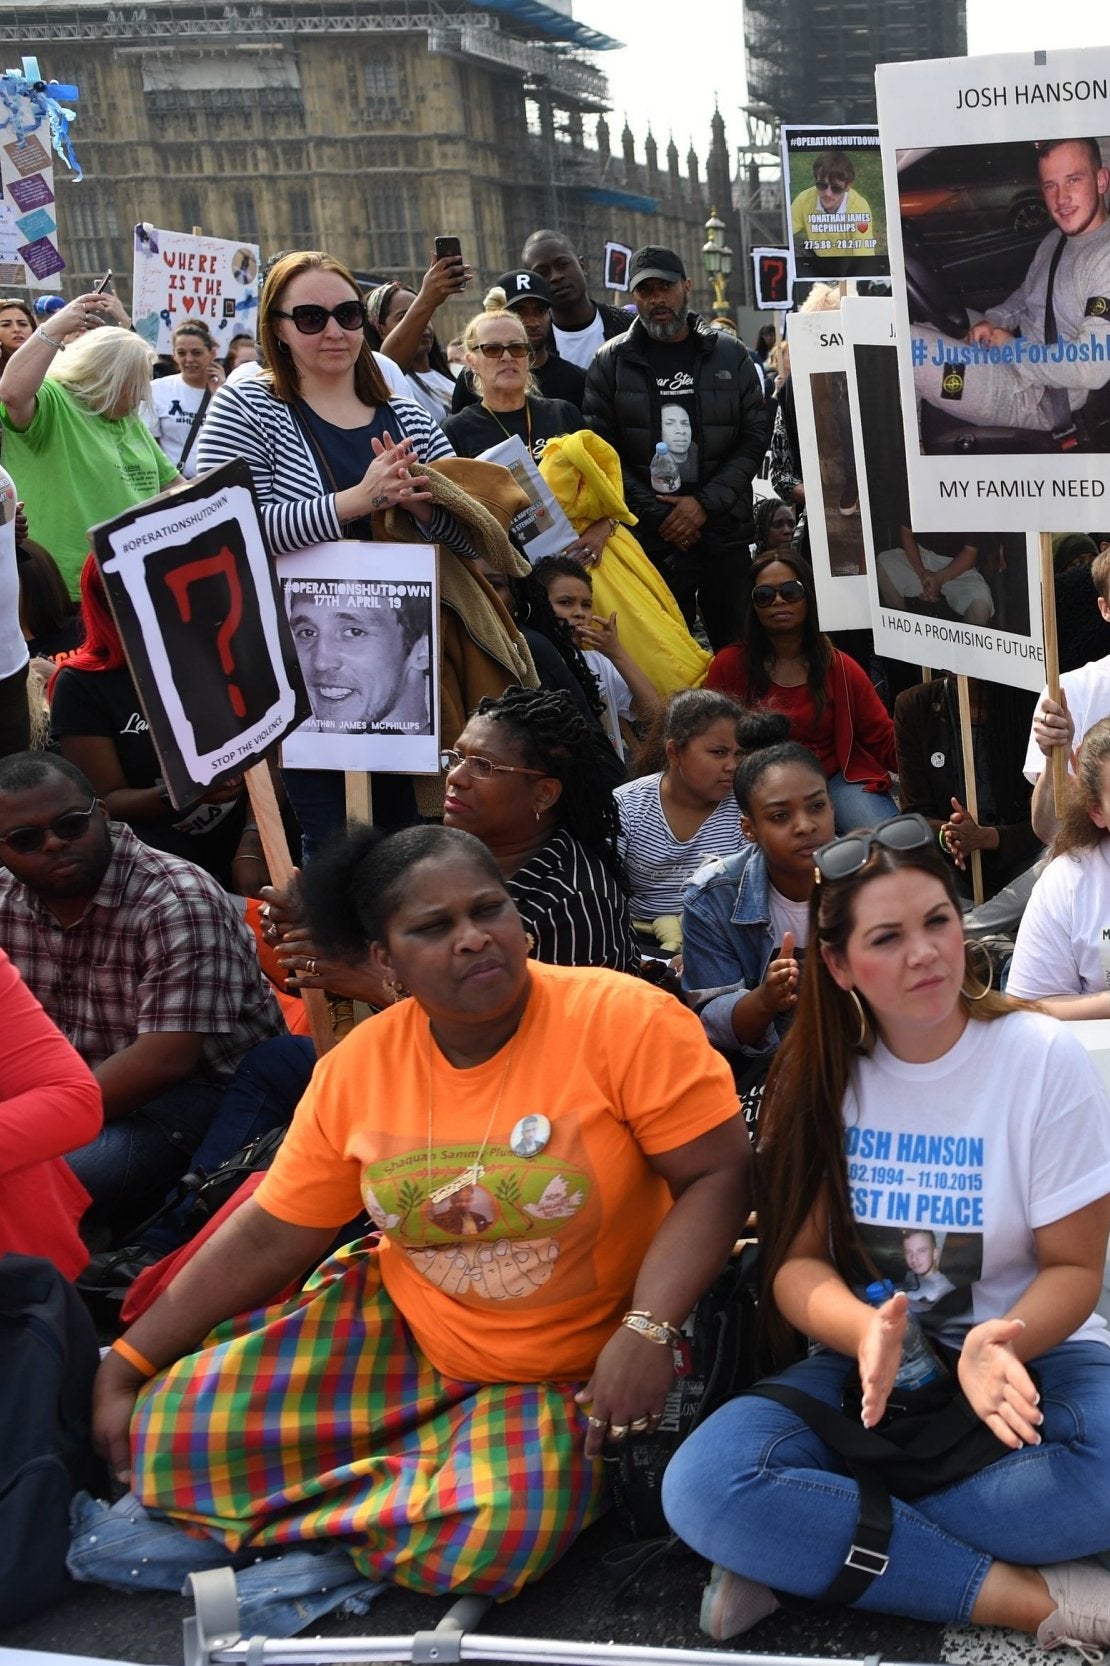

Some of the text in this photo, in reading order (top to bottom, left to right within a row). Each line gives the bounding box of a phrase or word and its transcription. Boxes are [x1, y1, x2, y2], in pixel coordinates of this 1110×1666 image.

[956, 79, 1108, 109] JOSH HANSON
[808, 213, 871, 223] JONATHAN JAMES
[811, 223, 856, 233] MCPHILLIPS
[865, 239, 877, 248] RIP
[163, 251, 217, 274] WHERE
[169, 275, 222, 296] IS THE
[516, 274, 532, 290] R
[939, 481, 970, 498] MY
[976, 480, 1045, 498] FAMILY
[1052, 480, 1105, 497] NEED
[122, 495, 229, 553] #OPERATIONSHUTDOWN
[284, 582, 430, 598] #OPERATIONSHUTDOWN
[314, 595, 402, 609] 17TH APRIL 19
[881, 615, 1043, 662] I HAD A PROMISING FUTURE
[339, 720, 367, 730] JAMES
[371, 721, 420, 730] MCPHILLIPS
[211, 714, 285, 770] STOP THE VIOLENCE
[897, 1133, 984, 1167] HANSON
[919, 1171, 982, 1191] 11.10.2015
[849, 1187, 984, 1226] EST IN PEACE
[673, 1350, 684, 1368] NIKE
